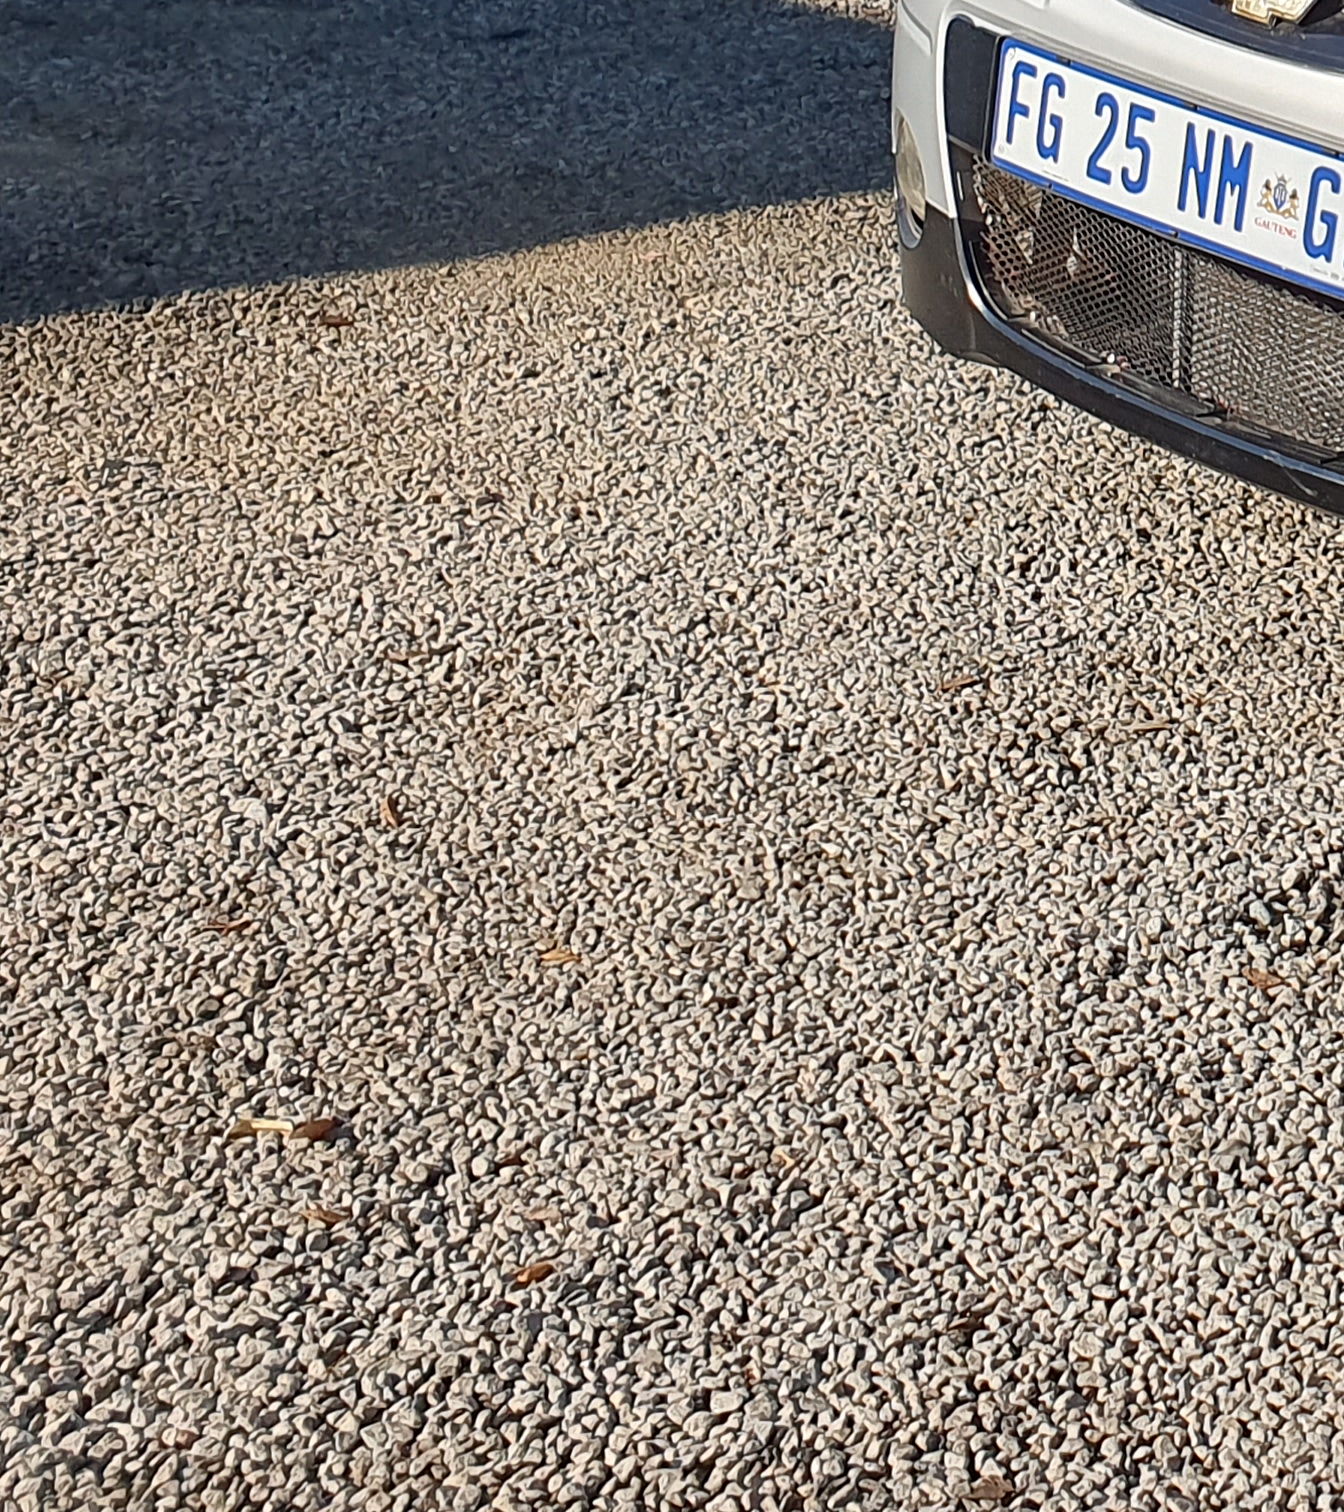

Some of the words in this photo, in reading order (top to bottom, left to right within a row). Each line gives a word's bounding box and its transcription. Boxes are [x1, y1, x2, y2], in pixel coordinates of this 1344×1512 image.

[1005, 59, 1067, 165] FG
[1086, 91, 1156, 195] 25
[1177, 121, 1254, 233] NM
[1254, 217, 1298, 240] GAUTENG
